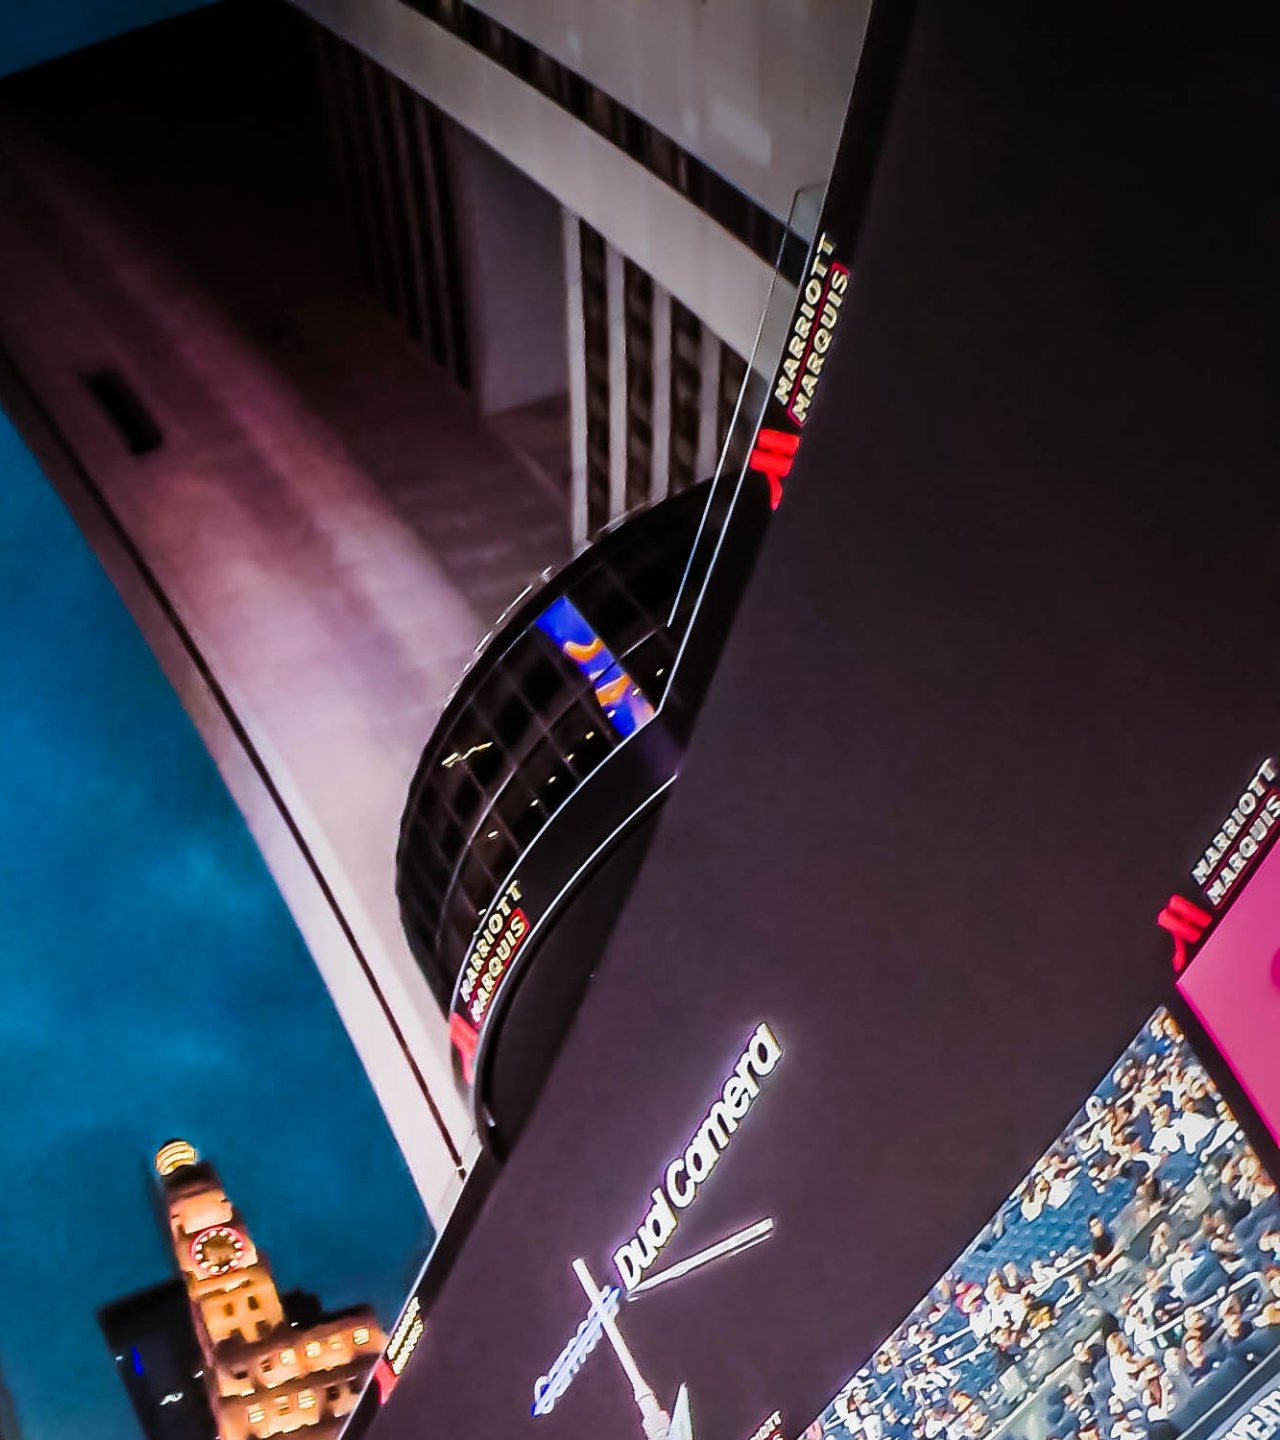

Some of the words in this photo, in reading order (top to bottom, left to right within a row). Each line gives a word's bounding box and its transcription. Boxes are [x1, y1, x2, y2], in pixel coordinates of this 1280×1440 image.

[774, 231, 837, 406] MARRIOTT
[792, 270, 849, 423] MARQUIS
[1192, 757, 1279, 886] MARRIOTT
[459, 879, 523, 1003] MARRIOTT
[470, 916, 526, 1023] MARQUIS
[666, 1022, 784, 1209] Camera
